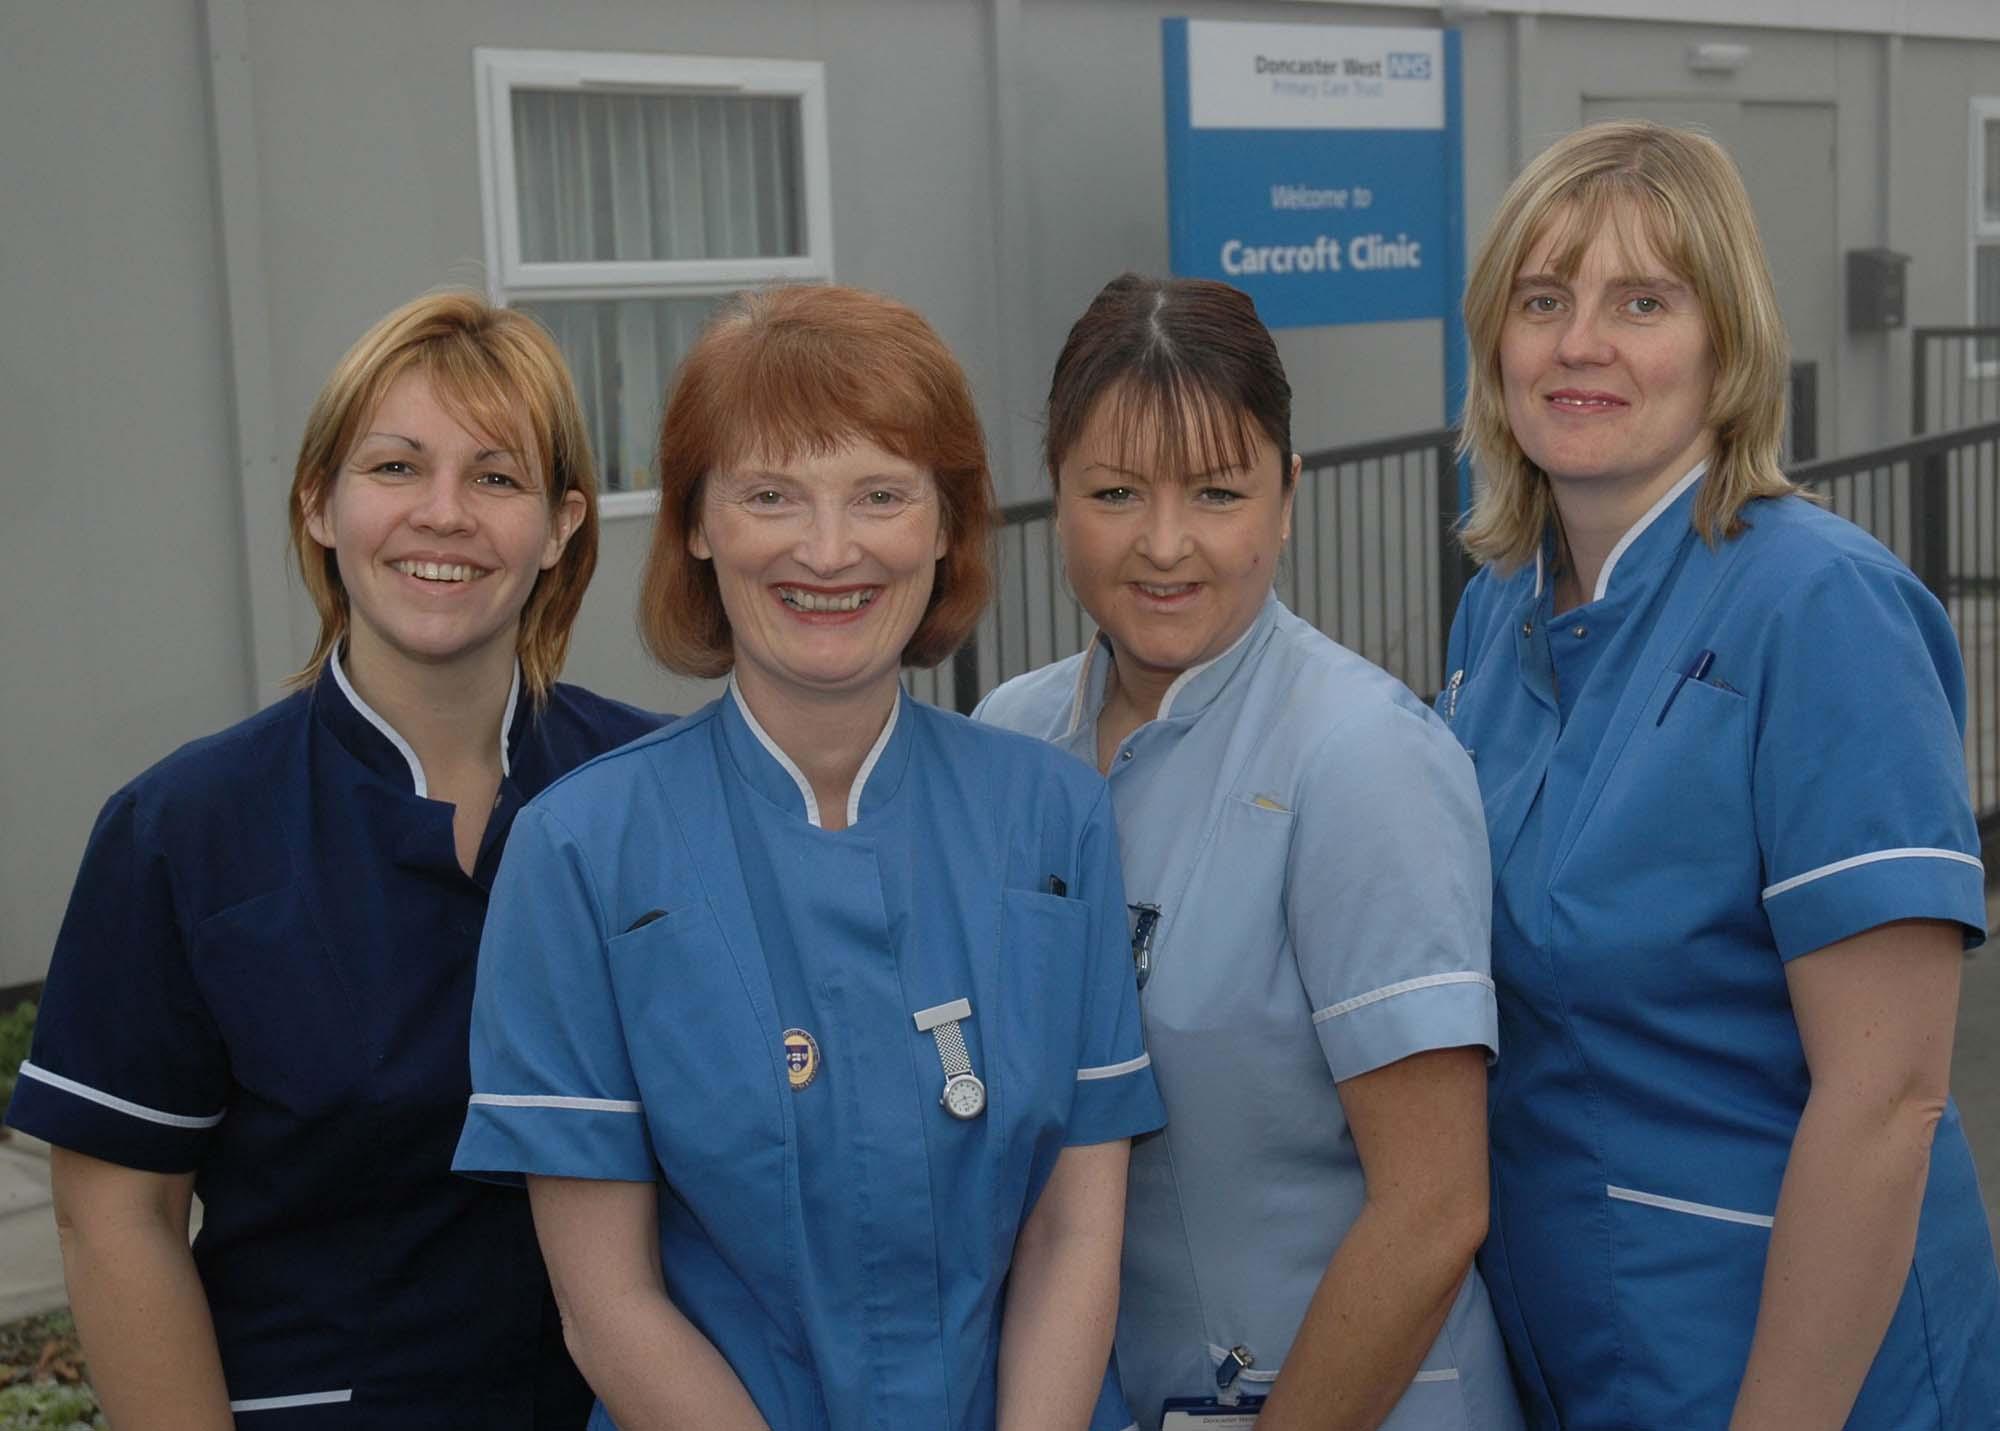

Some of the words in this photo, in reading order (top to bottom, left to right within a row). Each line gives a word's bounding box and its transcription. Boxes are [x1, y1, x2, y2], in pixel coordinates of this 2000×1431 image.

[1254, 55, 1338, 75] Doncaster
[1343, 58, 1382, 77] West
[1389, 54, 1429, 78] NHS
[1270, 184, 1348, 209] Welcome
[1354, 187, 1372, 208] to
[1221, 236, 1341, 275] Carcroft
[1350, 234, 1421, 270] Clinic
